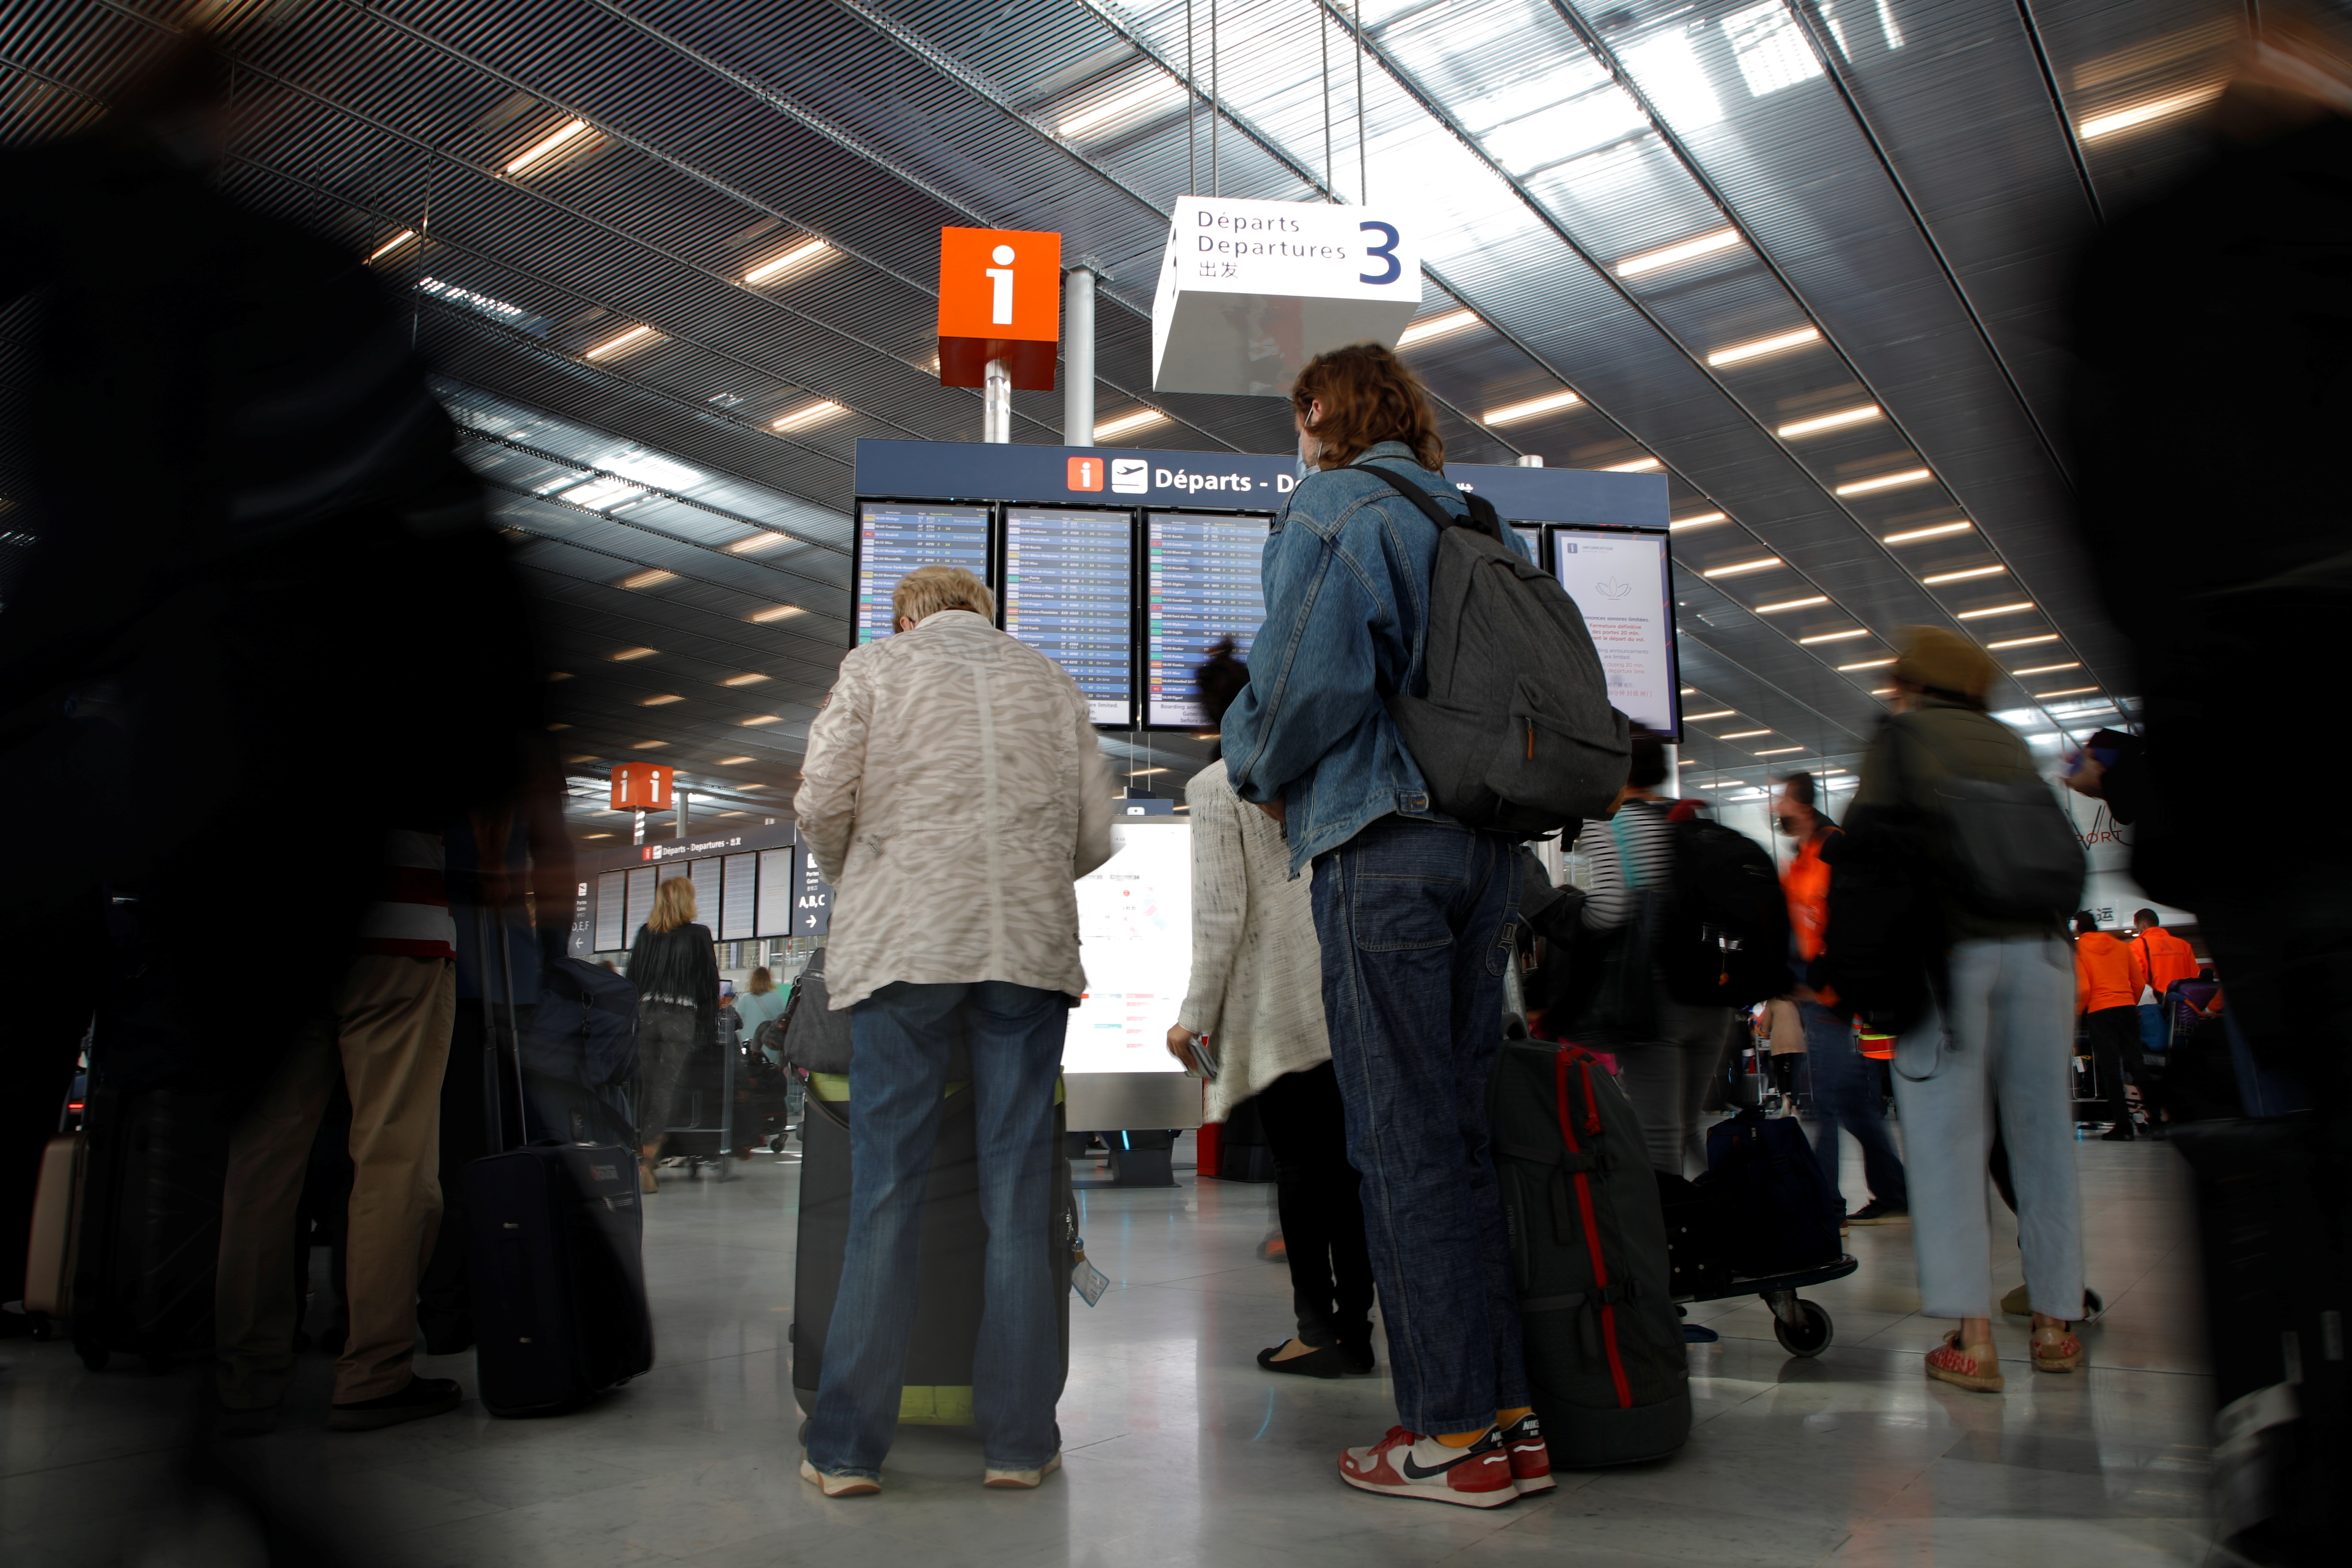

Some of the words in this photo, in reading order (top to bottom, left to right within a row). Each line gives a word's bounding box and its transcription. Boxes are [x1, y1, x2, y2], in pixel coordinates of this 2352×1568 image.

[1198, 211, 1299, 233] Départs
[1198, 235, 1345, 259] Departures
[1359, 220, 1402, 285] 3
[1199, 260, 1238, 279] 出发
[1155, 469, 1252, 494] Départs
[662, 845, 686, 856] Départs
[690, 840, 725, 852] Departures
[799, 894, 826, 909] A,B,C
[1506, 1205, 1515, 1234] HYBRID
